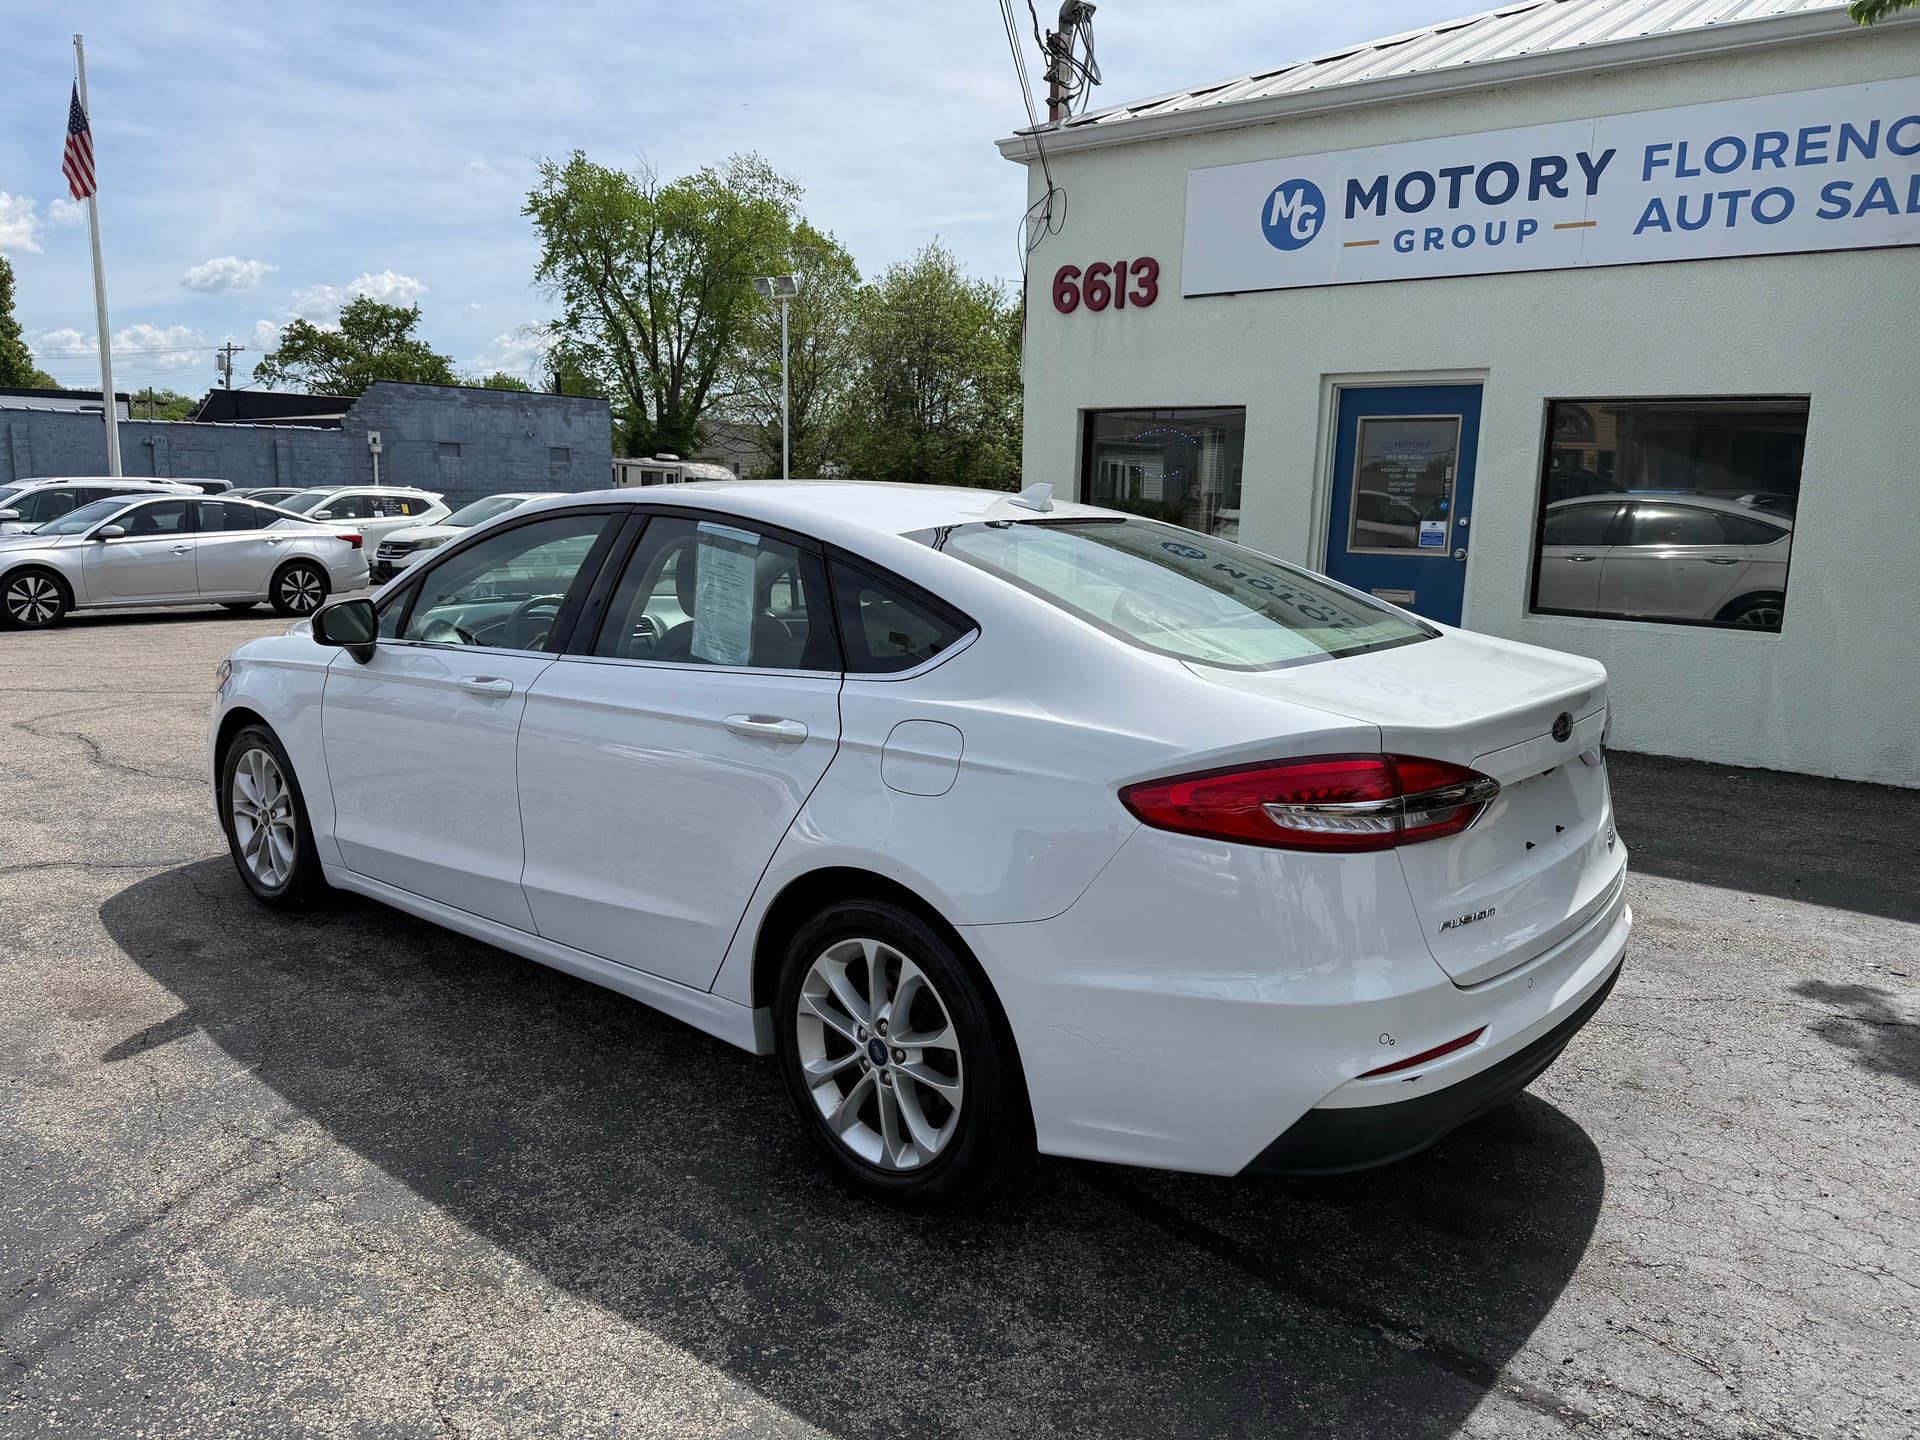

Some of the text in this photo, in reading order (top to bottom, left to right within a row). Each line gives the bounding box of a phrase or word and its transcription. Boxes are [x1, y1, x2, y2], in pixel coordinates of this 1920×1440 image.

[1642, 115, 1920, 182] FLORENC
[1345, 148, 1617, 219] MOTORY
[1632, 186, 1795, 235] AUTO
[1269, 188, 1318, 240] MG
[1393, 218, 1538, 253] GROUP
[1052, 256, 1160, 314] 6613
